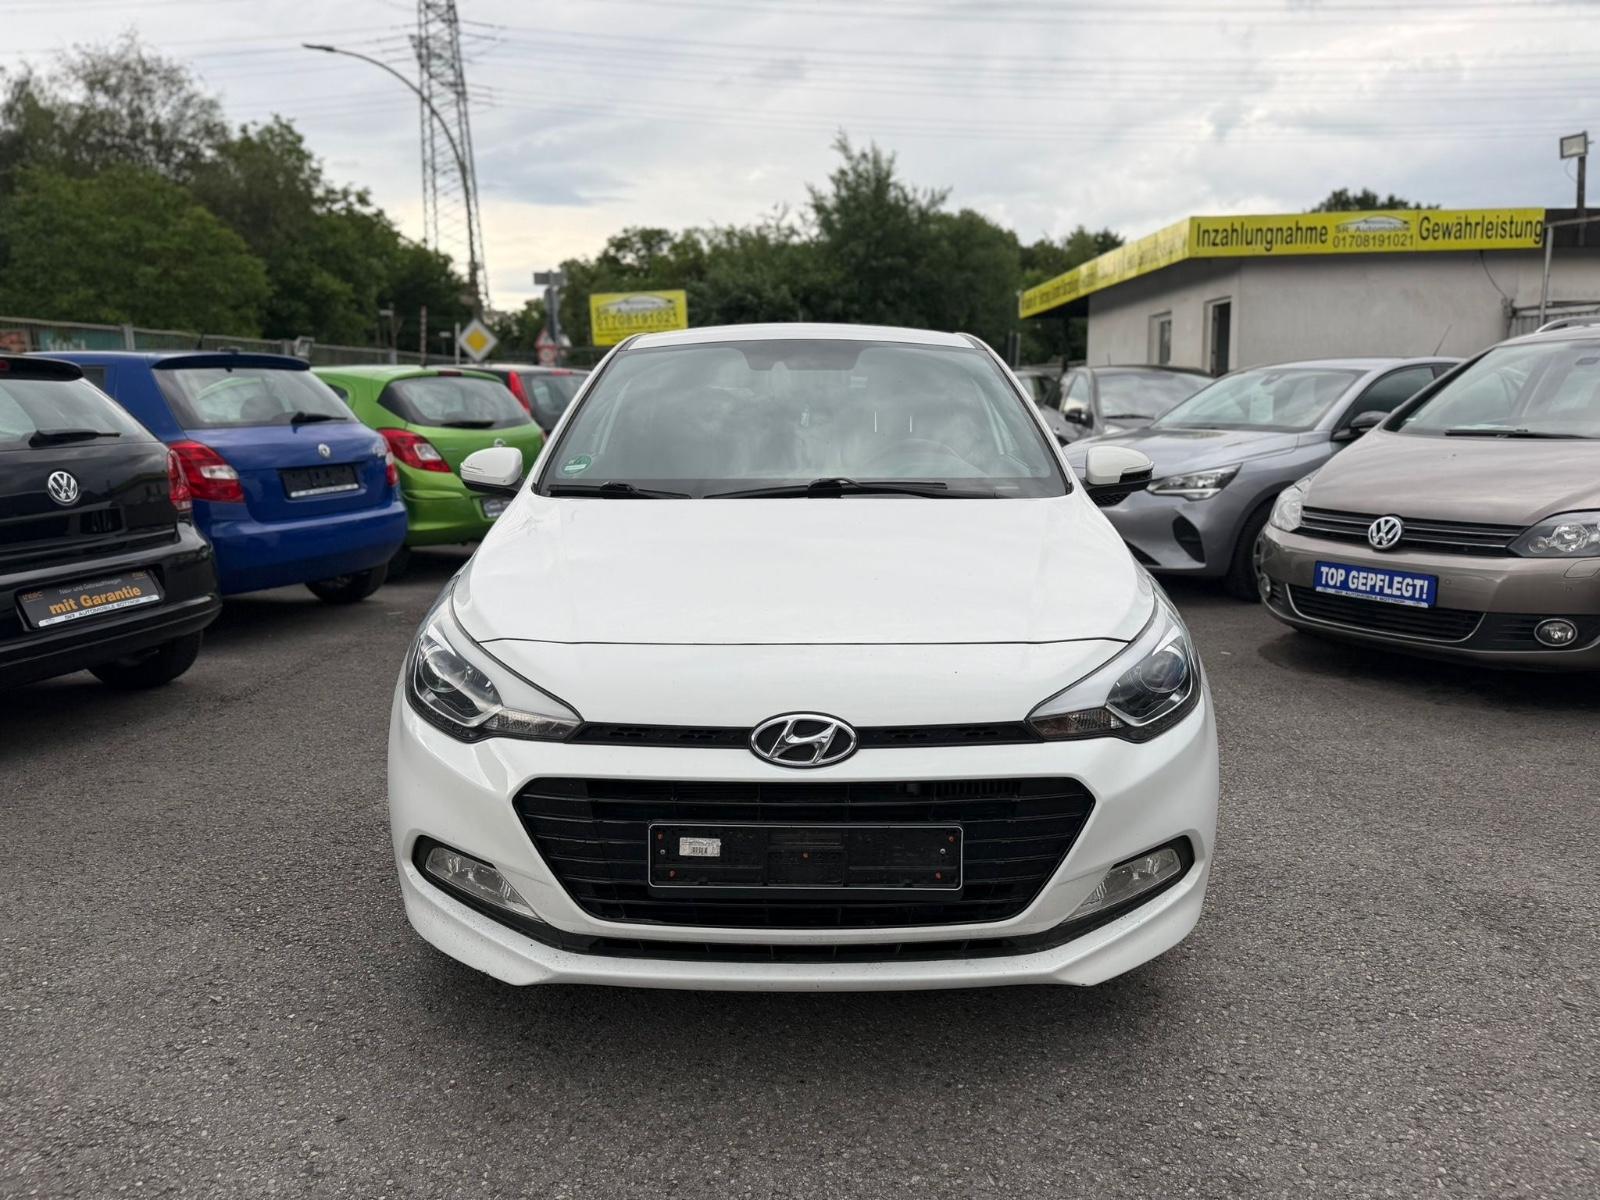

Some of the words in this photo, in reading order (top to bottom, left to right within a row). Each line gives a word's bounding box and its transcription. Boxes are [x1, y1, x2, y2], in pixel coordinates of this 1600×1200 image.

[1196, 220, 1328, 252] Inzahlungnahme
[1332, 232, 1415, 248] 01708191021
[1419, 214, 1544, 245] Gewährleistung
[1320, 566, 1346, 587] TOP
[1348, 570, 1429, 600] GEPFLEGT!
[49, 597, 79, 615] mit
[80, 585, 142, 607] Garantie
